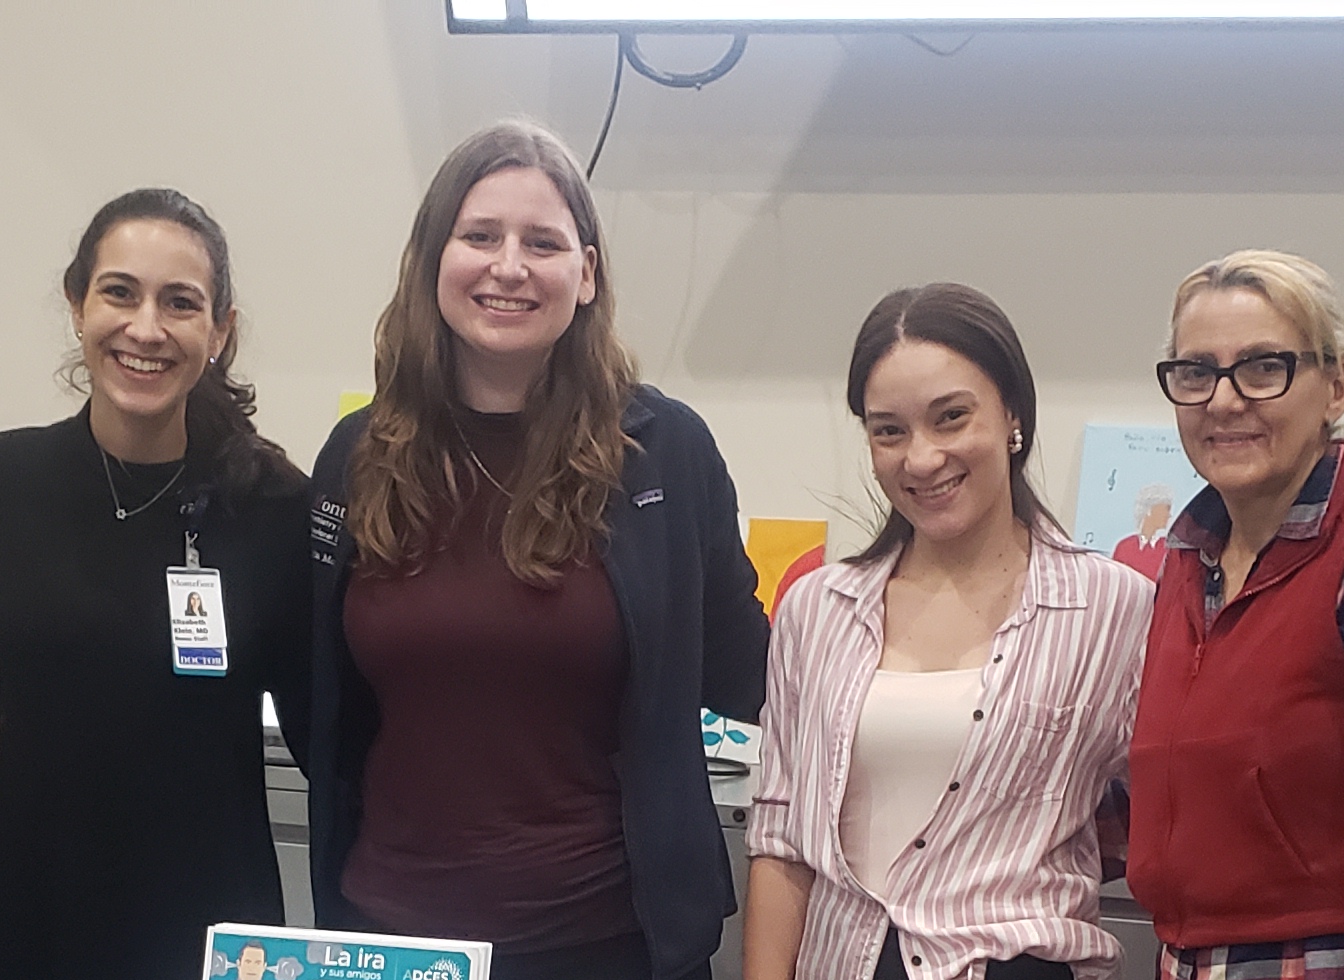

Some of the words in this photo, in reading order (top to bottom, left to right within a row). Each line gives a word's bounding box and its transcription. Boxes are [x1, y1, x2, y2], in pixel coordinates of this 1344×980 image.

[180, 655, 222, 665] DOCTOR
[323, 945, 350, 967] La
[358, 947, 385, 970] ira
[320, 969, 327, 978] y
[329, 969, 345, 979] sus
